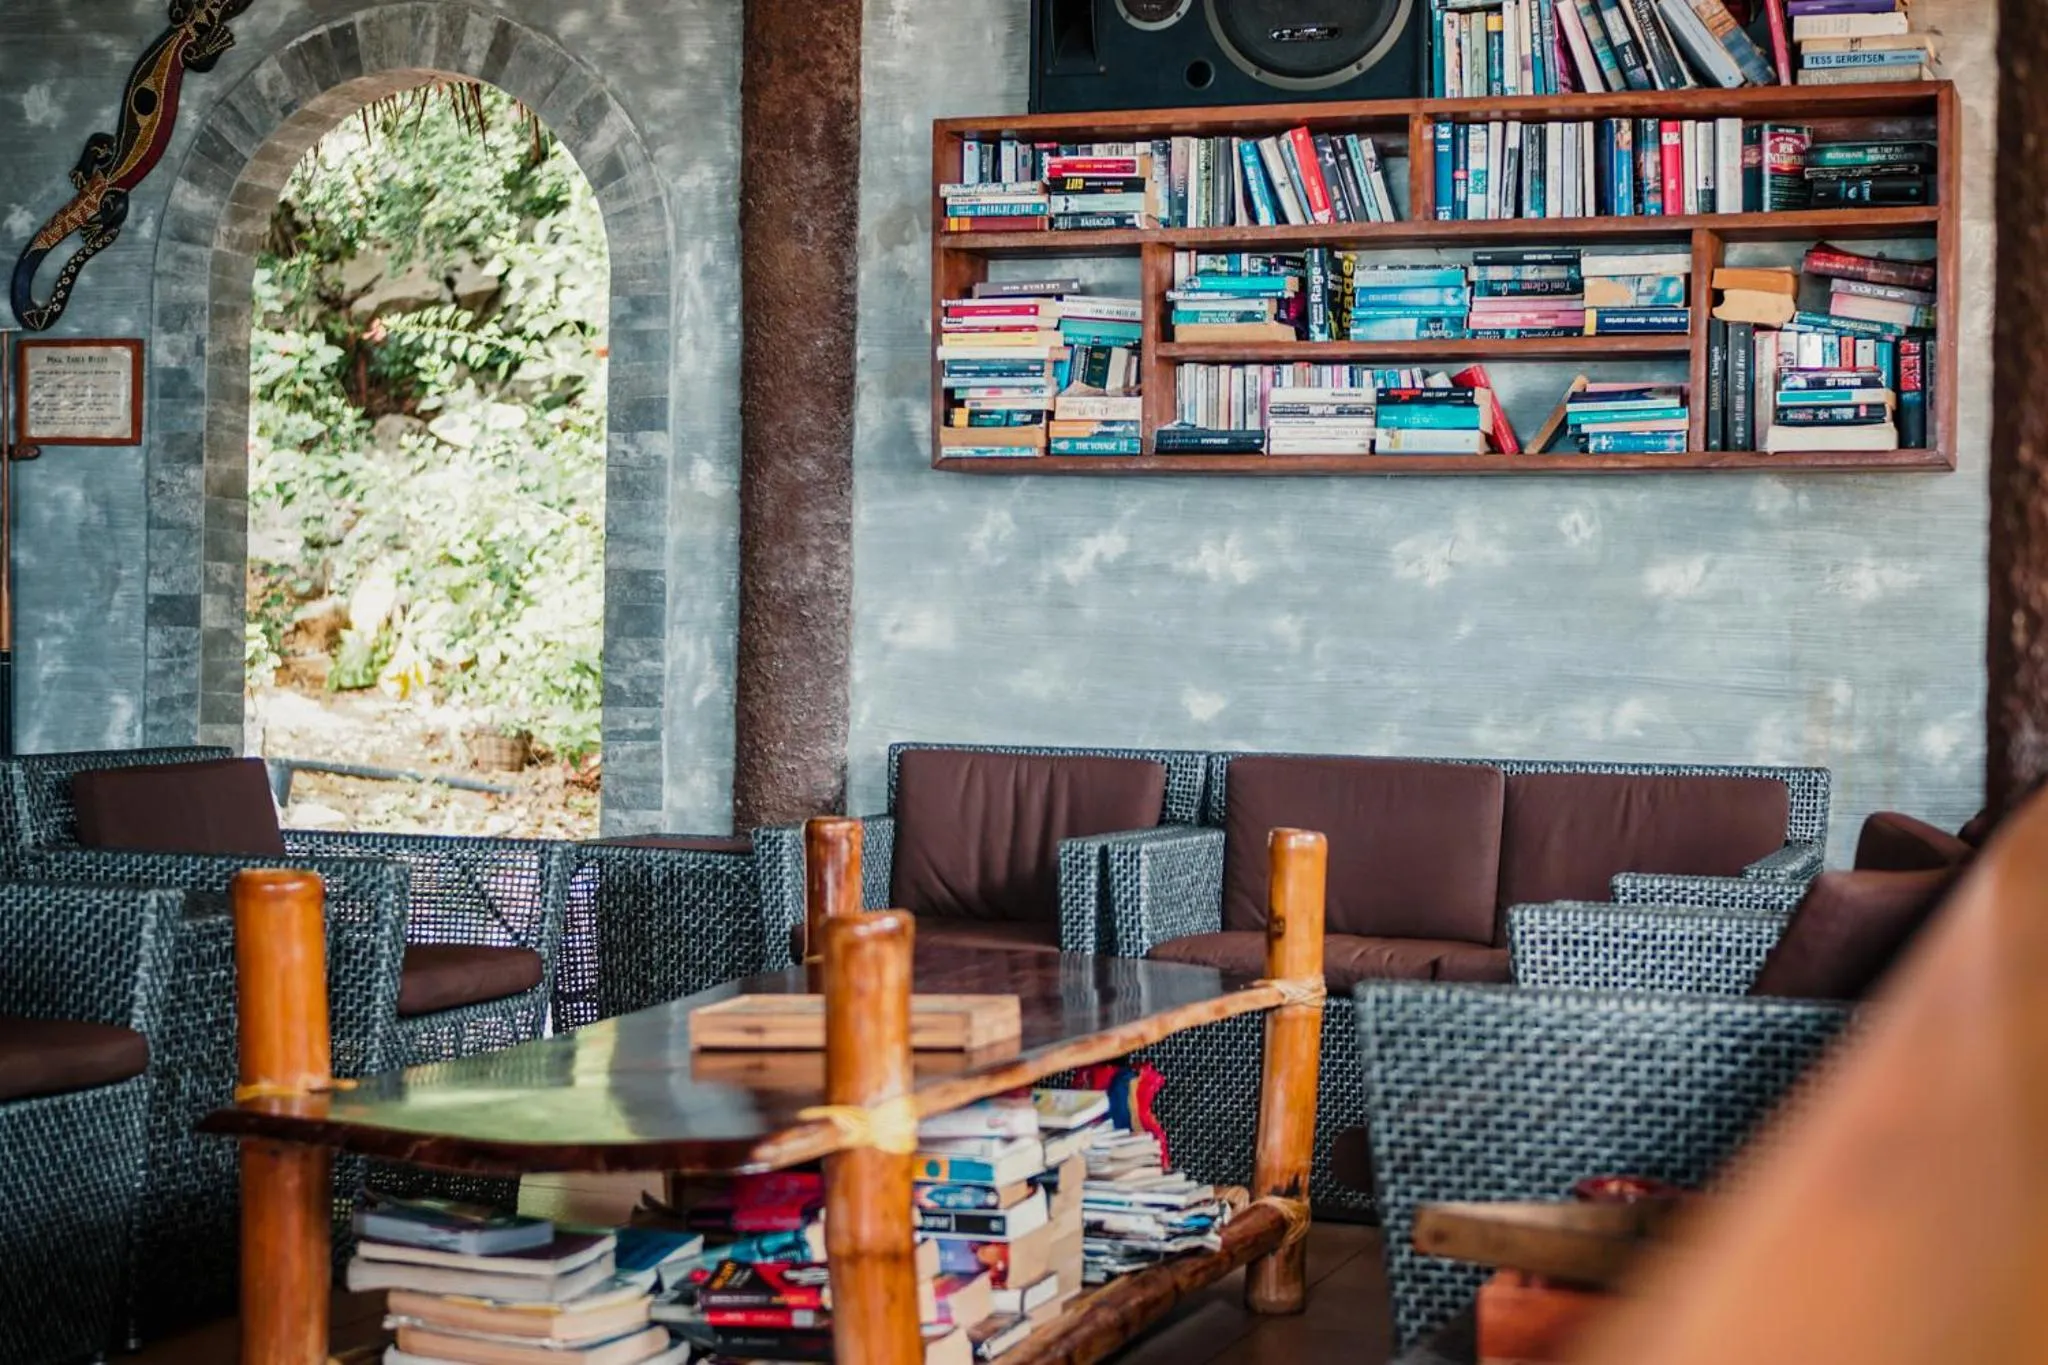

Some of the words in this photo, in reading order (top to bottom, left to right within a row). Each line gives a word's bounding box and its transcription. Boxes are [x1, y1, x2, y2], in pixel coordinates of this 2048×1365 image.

[1809, 55, 1832, 65] TESS
[1835, 53, 1885, 64] GERRITSEN
[1311, 267, 1323, 302] Rage
